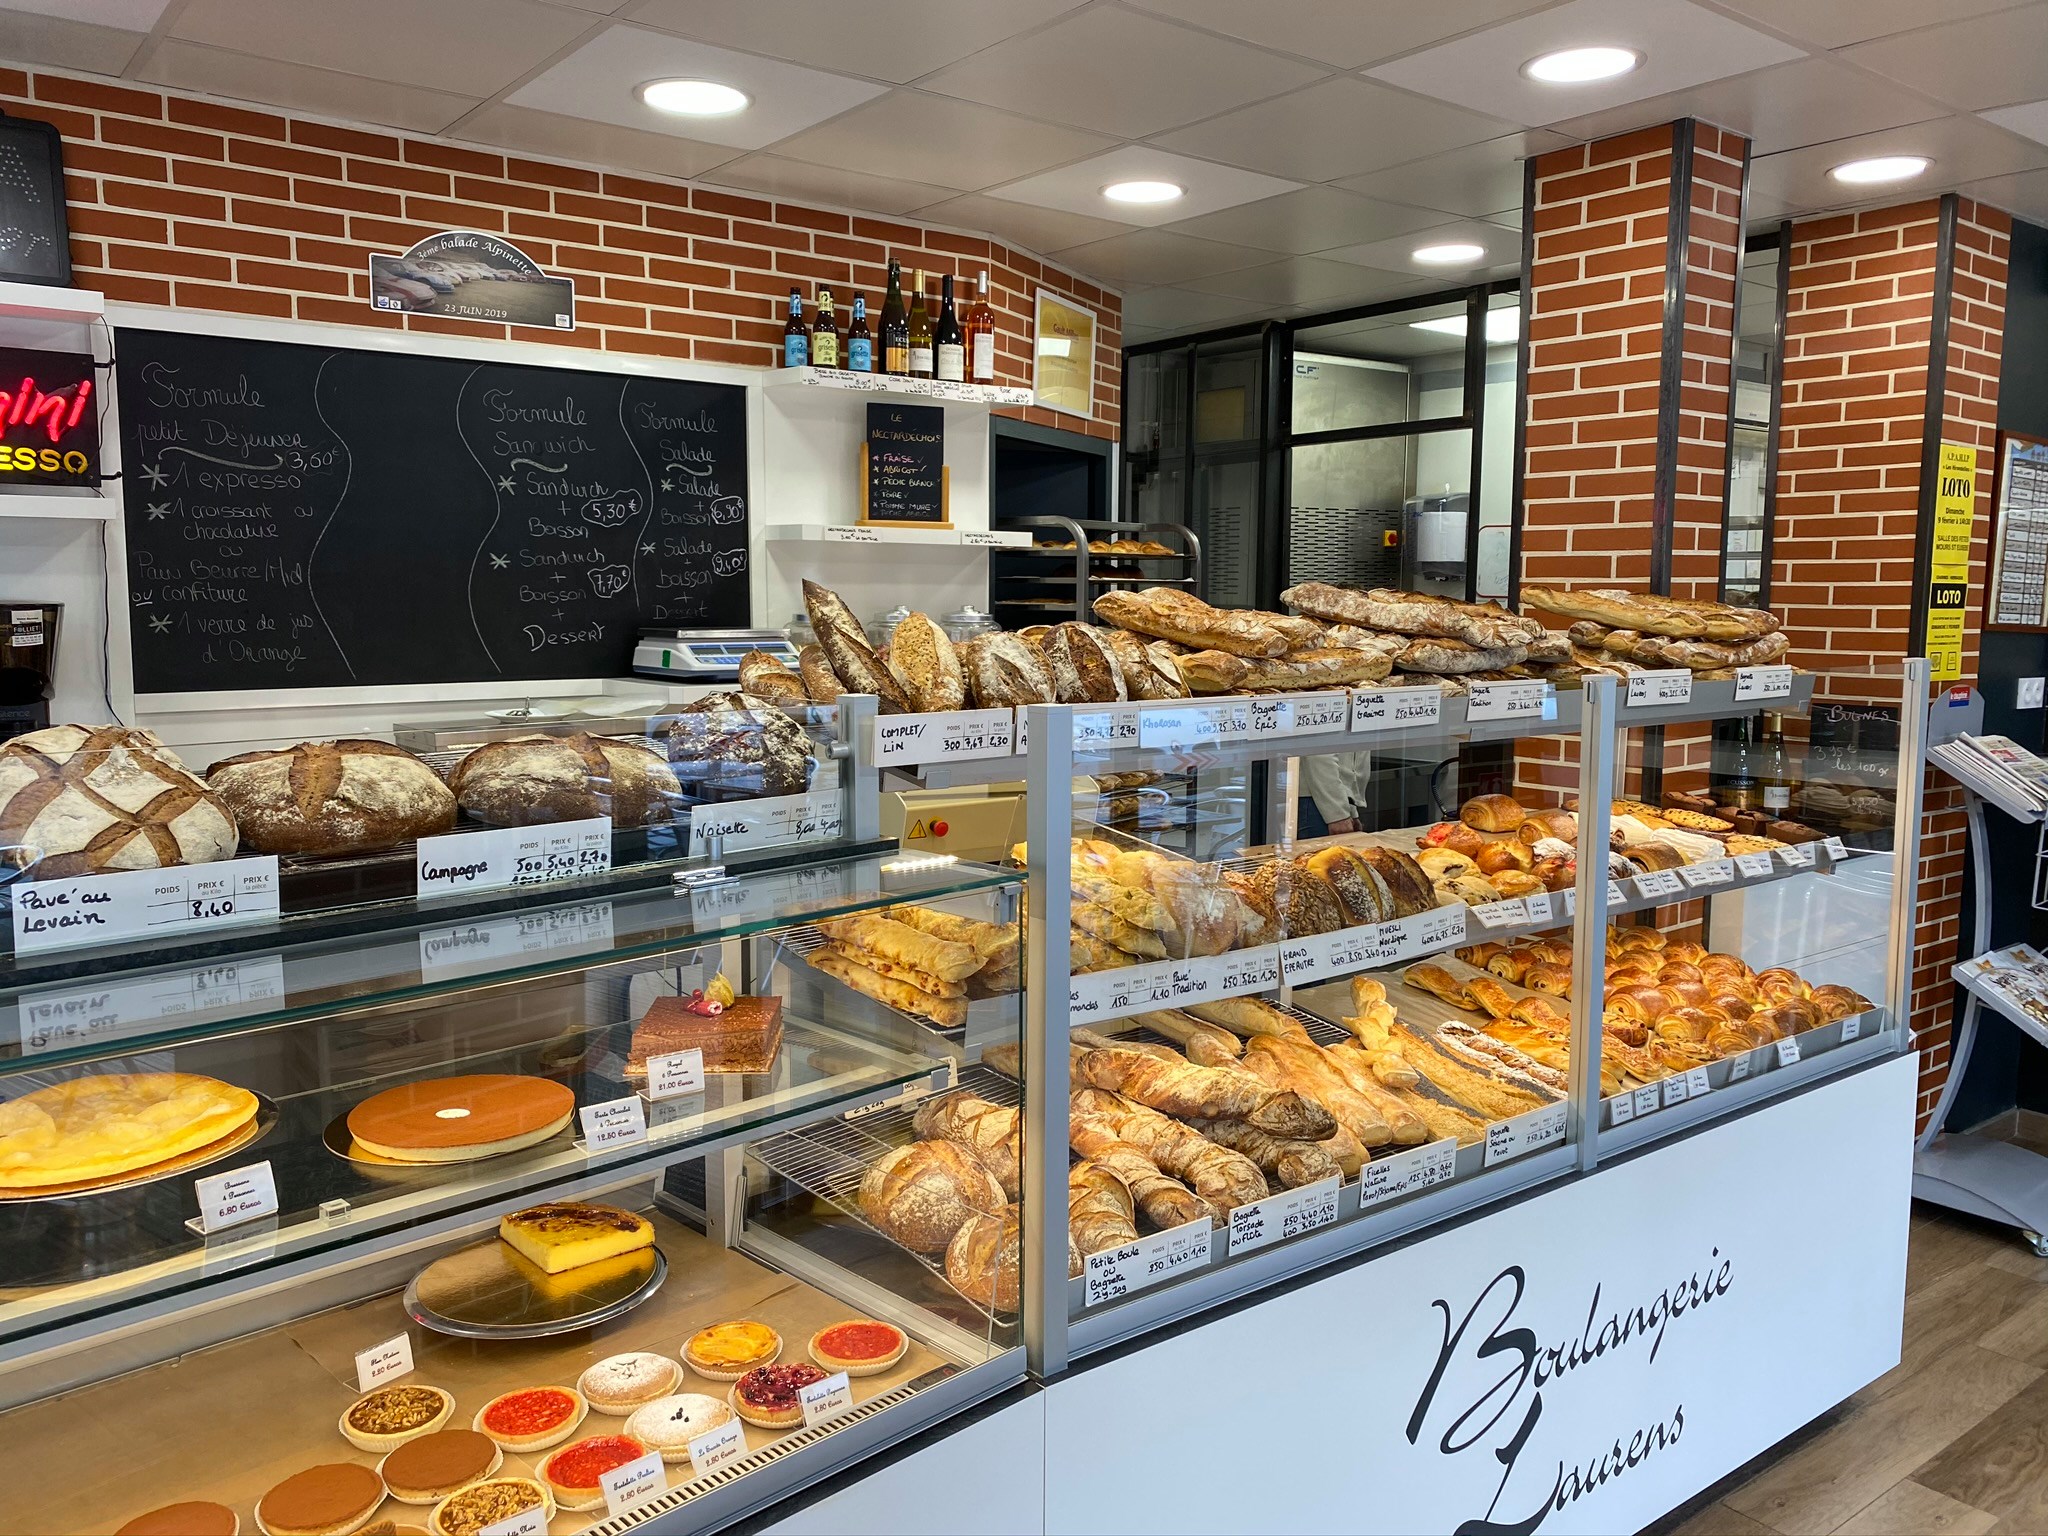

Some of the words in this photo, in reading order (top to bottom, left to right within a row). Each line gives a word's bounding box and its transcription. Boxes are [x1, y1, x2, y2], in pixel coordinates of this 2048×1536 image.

[441, 237, 478, 250] balade
[482, 242, 532, 275] Alpinette
[444, 304, 456, 312] 23
[458, 305, 483, 315] JUIN
[485, 309, 507, 318] 2019
[142, 362, 265, 408] Formule
[483, 390, 587, 426] Formule
[635, 402, 718, 432] Formule
[132, 421, 187, 457] petit
[660, 440, 716, 462] Salade
[199, 474, 301, 492] expresso
[527, 472, 608, 497] Sandwich
[679, 476, 722, 496] Salade
[1942, 478, 1970, 498] LOTO
[191, 504, 272, 519] croissant
[661, 510, 710, 526] Boisson
[529, 518, 588, 538] Boisson
[664, 538, 712, 556] Salade
[520, 549, 604, 566] Sandwich
[163, 585, 248, 602] confiture
[520, 585, 586, 602] Boisson
[1937, 590, 1961, 604] LOTO
[199, 616, 246, 633] verre
[257, 614, 276, 631] de
[290, 614, 313, 644] jus
[1251, 702, 1287, 716] Baguette
[1356, 695, 1384, 707] Baguette
[1296, 714, 1309, 727] 250
[1313, 712, 1328, 725] 4,20
[1330, 712, 1342, 723] 1,05
[1395, 708, 1407, 719] 250
[1409, 705, 1423, 716] 4,40
[1424, 705, 1437, 716] 1,10
[1827, 705, 1889, 722] BUGNES
[1079, 728, 1094, 738] 350
[1120, 725, 1136, 737] 2,70
[1232, 721, 1246, 731] 3,70
[944, 740, 960, 750] 300
[965, 737, 982, 750] 7,67
[989, 736, 1008, 746] 2,30
[1832, 758, 1851, 770] les
[1857, 763, 1875, 772] 100
[696, 822, 748, 839] Noisette
[520, 842, 538, 850] POIDS
[422, 861, 488, 883] Campagne
[517, 858, 542, 872] 500
[548, 854, 574, 868] 5,40
[580, 850, 607, 864] 2,70
[155, 885, 180, 895] POIDS
[198, 881, 217, 890] PRIX
[243, 876, 262, 885] PRIX
[264, 875, 269, 883] €
[81, 890, 111, 904] au
[23, 911, 105, 933] Levain
[192, 901, 233, 917] 8,40
[1379, 934, 1407, 947] Nordique
[1421, 937, 1434, 946] 400
[1435, 929, 1448, 942] 6,75
[1283, 949, 1307, 961] GRAND
[1284, 958, 1314, 974] EPEAUTRE
[1331, 956, 1345, 966] 400
[1172, 981, 1207, 996] Tradition
[1223, 977, 1238, 990] 250
[1242, 973, 1257, 985] 5,20
[1112, 996, 1127, 1008] 150
[1152, 989, 1169, 1001] 1,10
[1490, 1126, 1510, 1139] Baguette
[1367, 1165, 1391, 1178] Ficelles
[1364, 1176, 1388, 1189] Nature
[1408, 1172, 1421, 1184] 125
[229, 1189, 255, 1199] Personnes
[219, 1206, 237, 1217] 6.80
[240, 1200, 261, 1210] Euros
[1233, 1207, 1261, 1223] Baguette
[1232, 1220, 1265, 1235] Torsade
[1283, 1215, 1298, 1227] 250
[1301, 1210, 1318, 1223] 4,40
[1319, 1204, 1335, 1216] 1,10
[1283, 1227, 1297, 1238] 400
[1091, 1254, 1116, 1270] Petite
[1118, 1247, 1140, 1262] Boule
[1148, 1261, 1164, 1272] 250
[1168, 1252, 1188, 1265] 4,40
[1191, 1245, 1206, 1258] 1,10
[1091, 1276, 1126, 1291] Baguette
[1406, 1246, 1734, 1454] Boulangerie
[387, 1361, 402, 1370] Euros
[828, 1399, 842, 1408] Euros
[721, 1449, 736, 1458] Euros
[1452, 1391, 1683, 1536] Laurens
[637, 1484, 654, 1494] Euros
